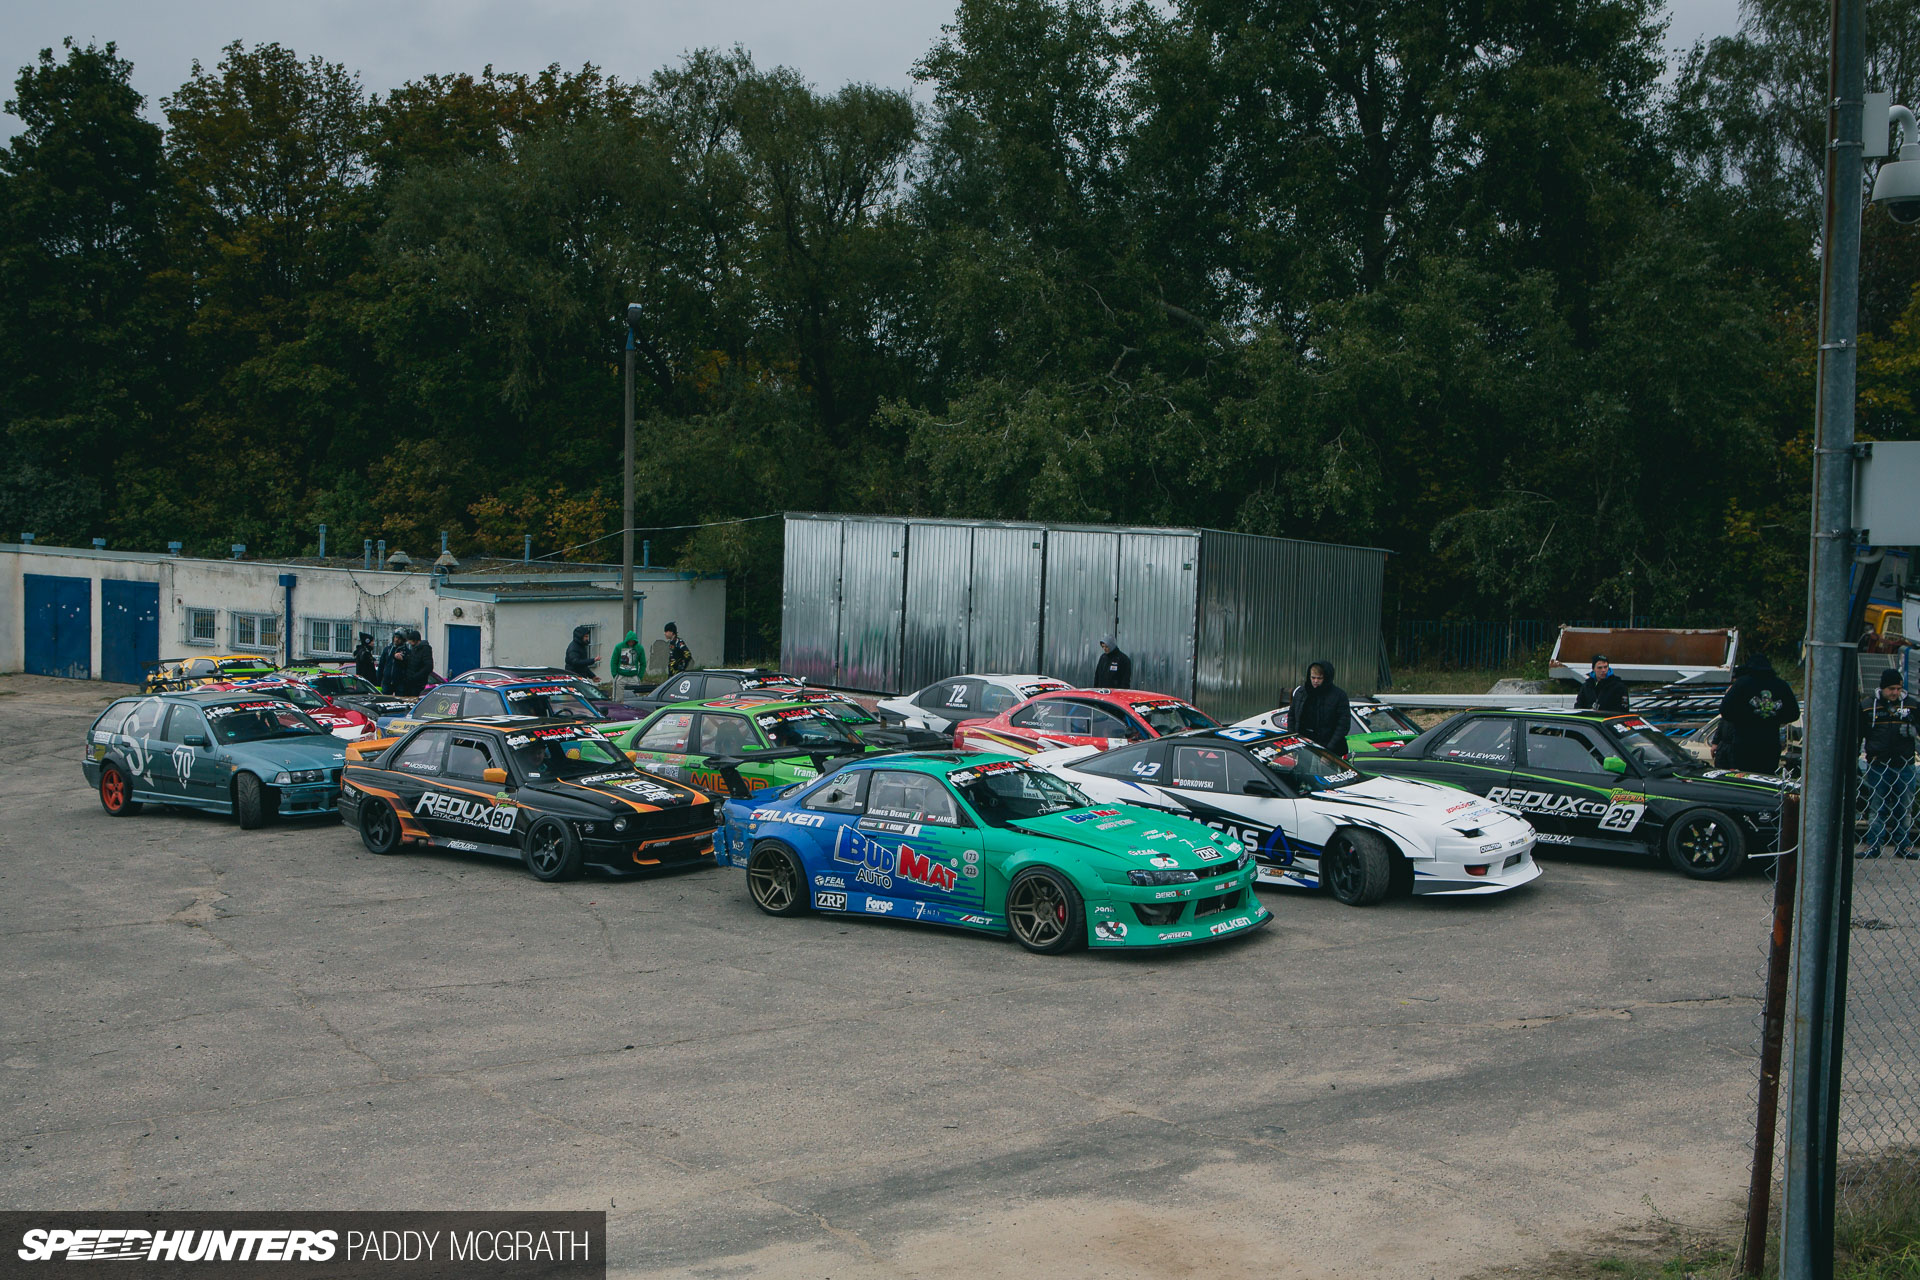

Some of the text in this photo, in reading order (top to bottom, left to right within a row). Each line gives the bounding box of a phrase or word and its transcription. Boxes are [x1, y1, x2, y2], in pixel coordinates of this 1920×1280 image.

[948, 684, 968, 703] 72
[176, 750, 191, 778] 70
[1458, 751, 1506, 761] ZALEWSKI
[1131, 761, 1162, 777] 43
[1180, 779, 1214, 788] BORKOWSKI
[414, 792, 494, 824] REDUX
[867, 807, 911, 819] JAMES DEANE
[492, 811, 513, 830] 80
[749, 809, 825, 828] FALKEN
[1605, 807, 1635, 829] 29
[911, 825, 916, 835] 1
[834, 824, 958, 892] BUD MAT
[965, 853, 977, 861] 173
[855, 868, 893, 889] AUTO
[965, 867, 977, 875] 223
[824, 876, 845, 886] FEAL
[817, 893, 845, 908] ZRP
[1209, 917, 1252, 935] FALKEN
